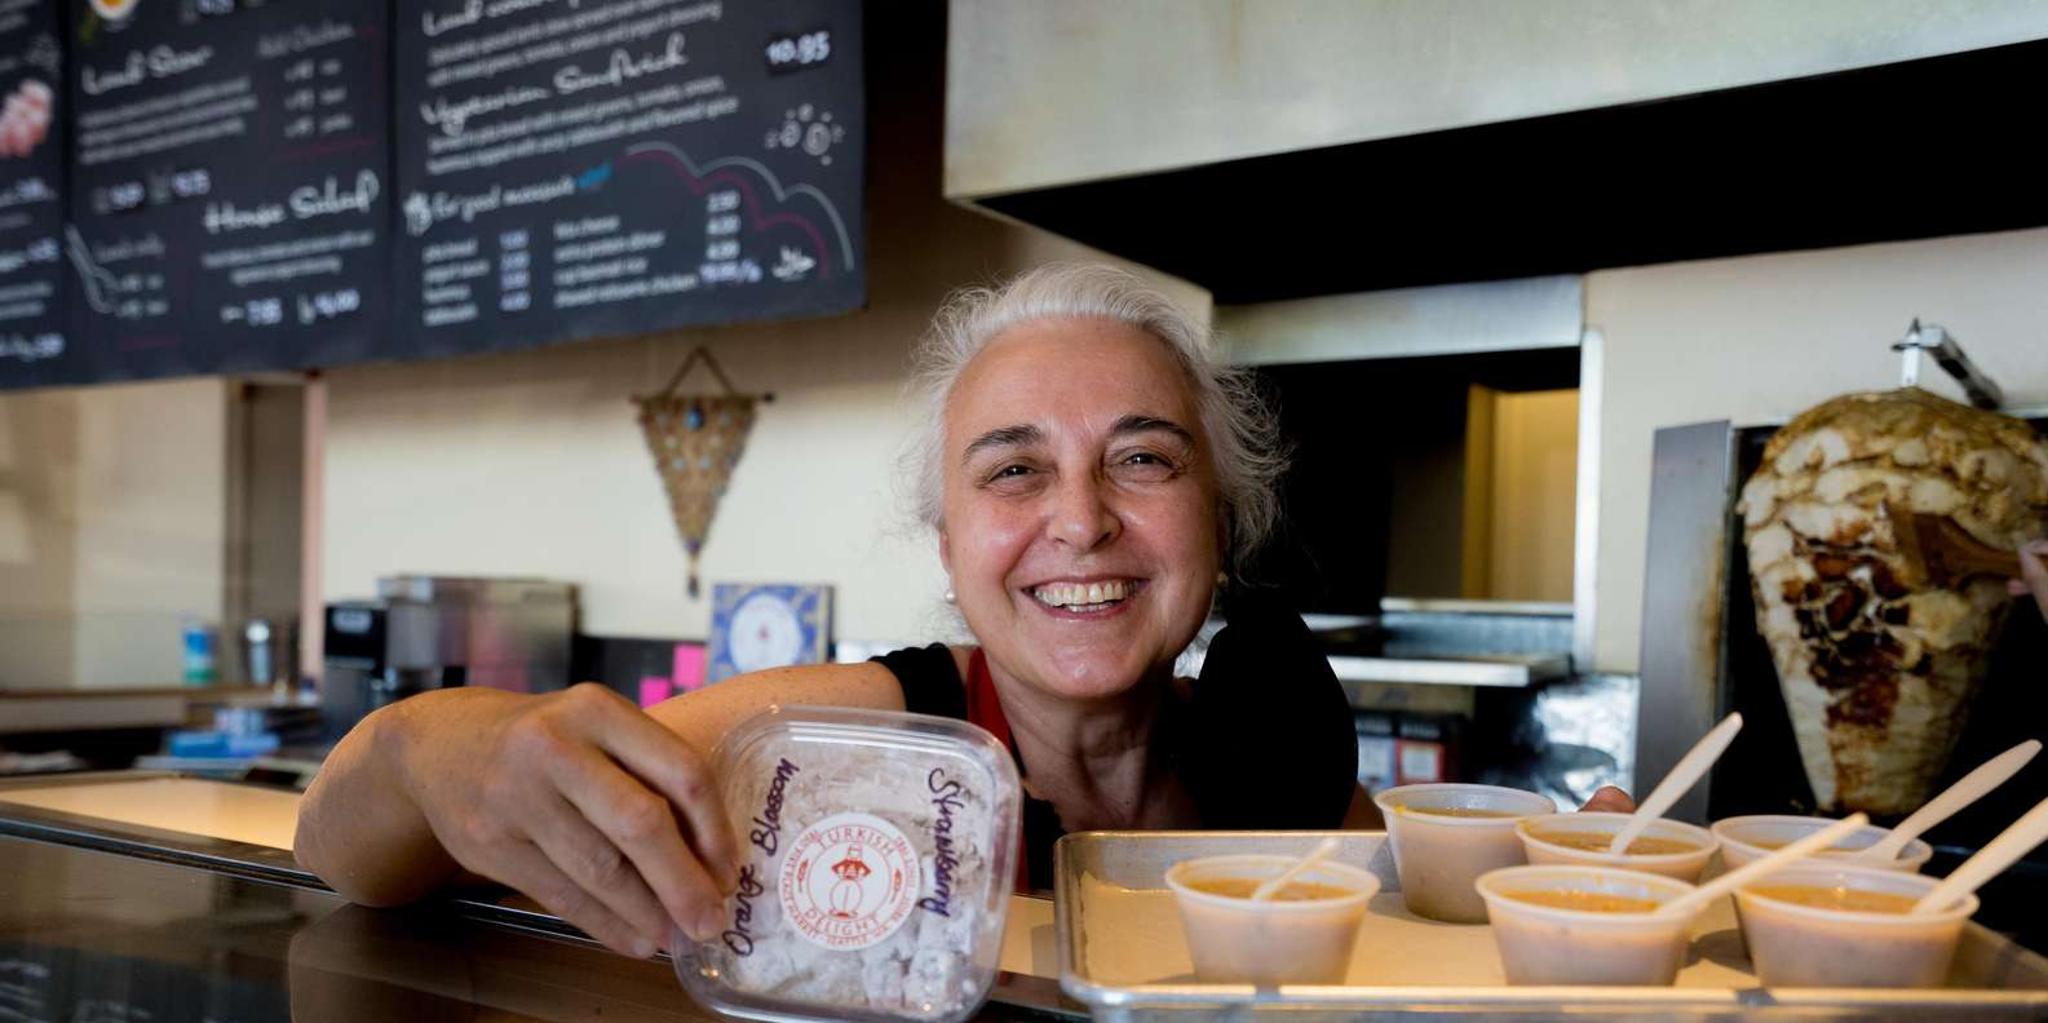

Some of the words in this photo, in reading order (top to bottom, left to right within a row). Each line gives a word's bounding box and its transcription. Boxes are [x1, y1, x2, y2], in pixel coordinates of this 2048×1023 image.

[722, 864, 764, 957] Orange
[750, 757, 800, 857] Blossom
[819, 825, 895, 856] TURKISH
[916, 767, 965, 917] Strawberry
[804, 907, 881, 936] DELIGHT
